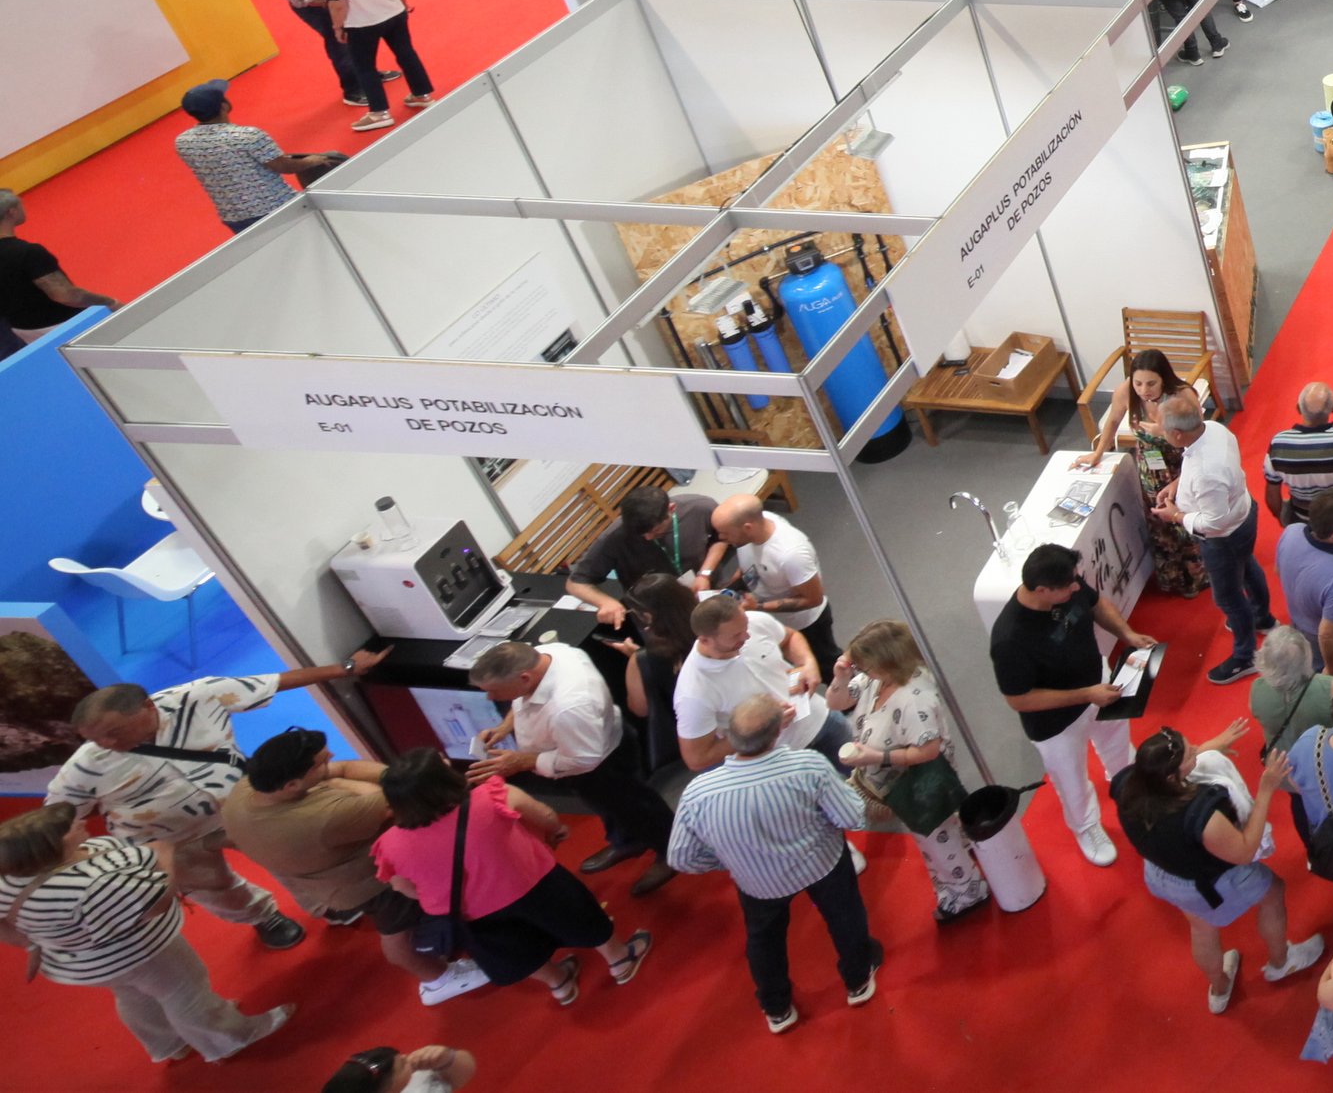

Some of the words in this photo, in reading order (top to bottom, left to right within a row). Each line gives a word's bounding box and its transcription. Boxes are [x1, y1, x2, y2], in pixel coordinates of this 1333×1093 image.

[959, 194, 1012, 261] AUGAPLUS
[1012, 110, 1083, 197] POTABILIZACIÓN
[1006, 211, 1022, 232] DE
[1022, 171, 1053, 214] POZOS
[967, 264, 986, 289] E-01
[304, 393, 413, 410] AUGAPLUS
[420, 398, 584, 419] POTABILIZACIÓN
[318, 422, 353, 433] E-01
[406, 418, 434, 432] DE
[440, 419, 508, 435] POZOS
